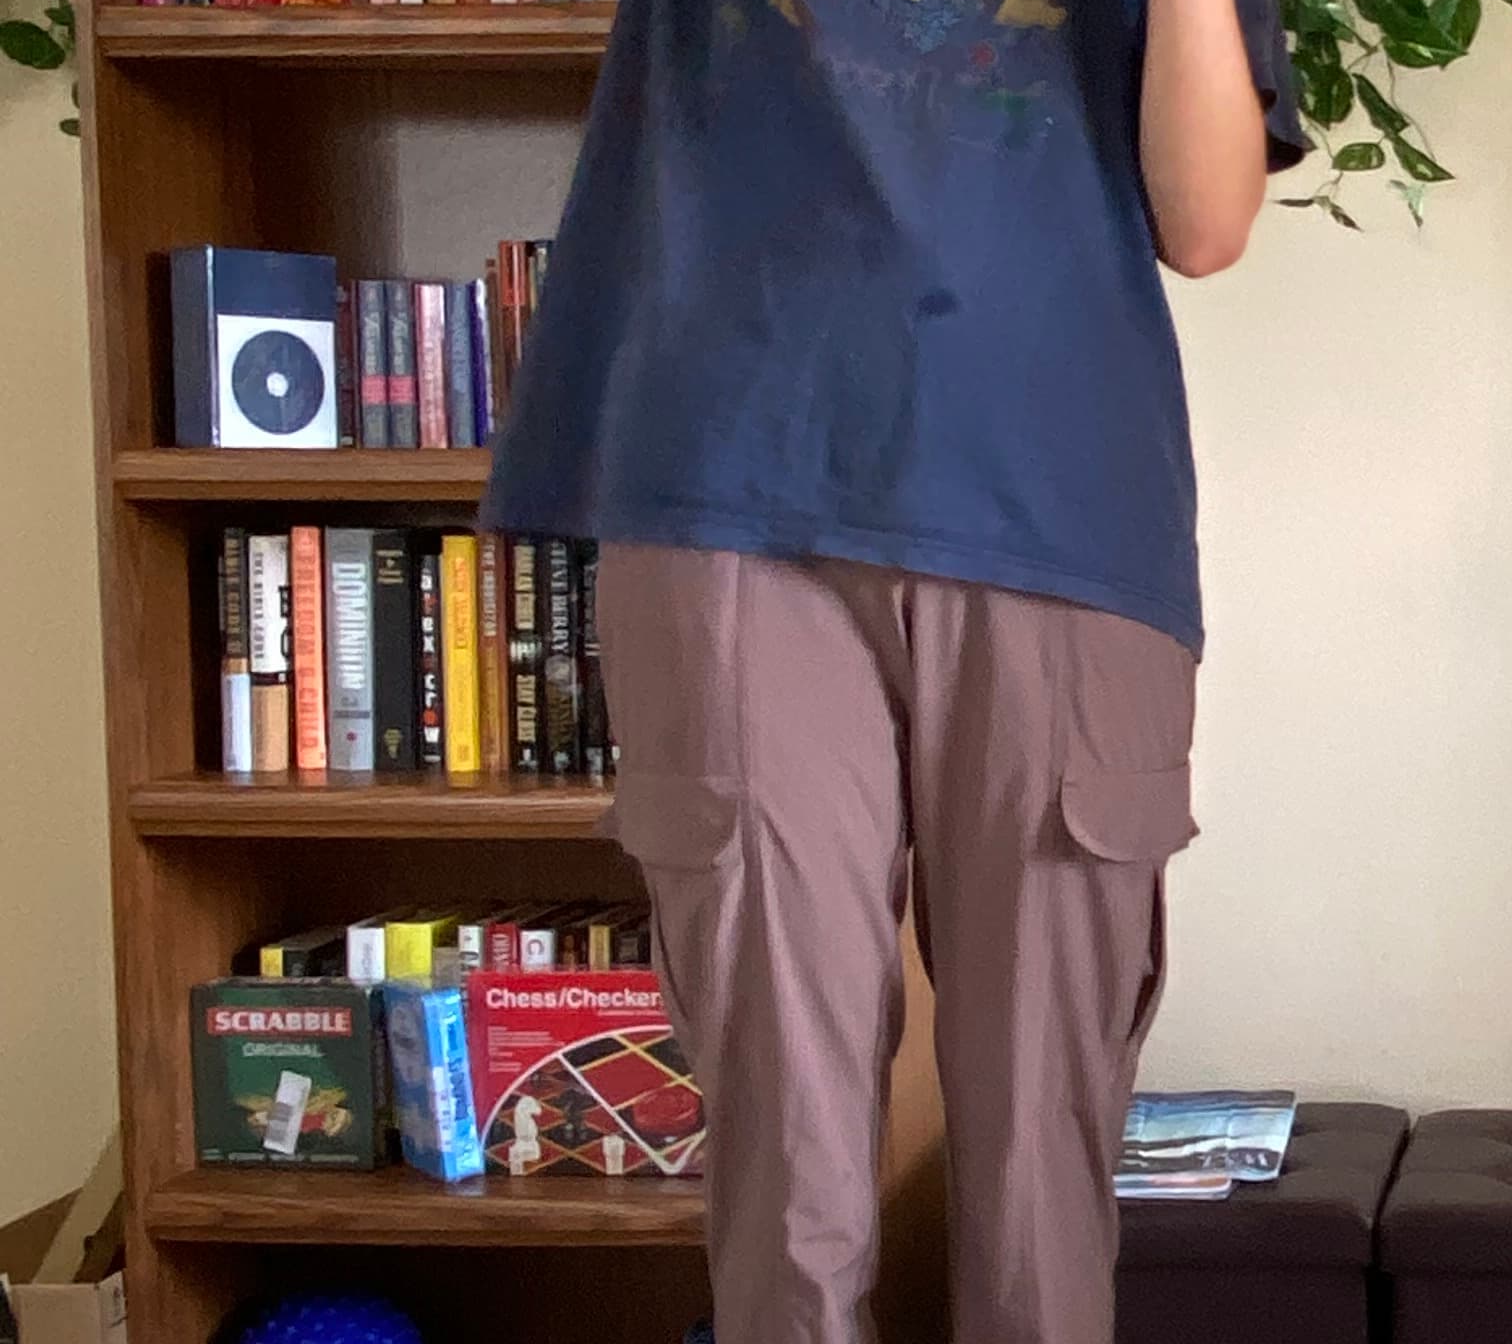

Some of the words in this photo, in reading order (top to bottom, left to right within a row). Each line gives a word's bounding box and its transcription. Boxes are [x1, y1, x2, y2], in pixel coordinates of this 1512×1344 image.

[332, 561, 368, 690] DOMINION
[549, 593, 570, 655] BERRY
[516, 673, 536, 705] STAY
[485, 987, 664, 1009] Chess/Checker
[214, 1010, 350, 1033] SCRABBLE
